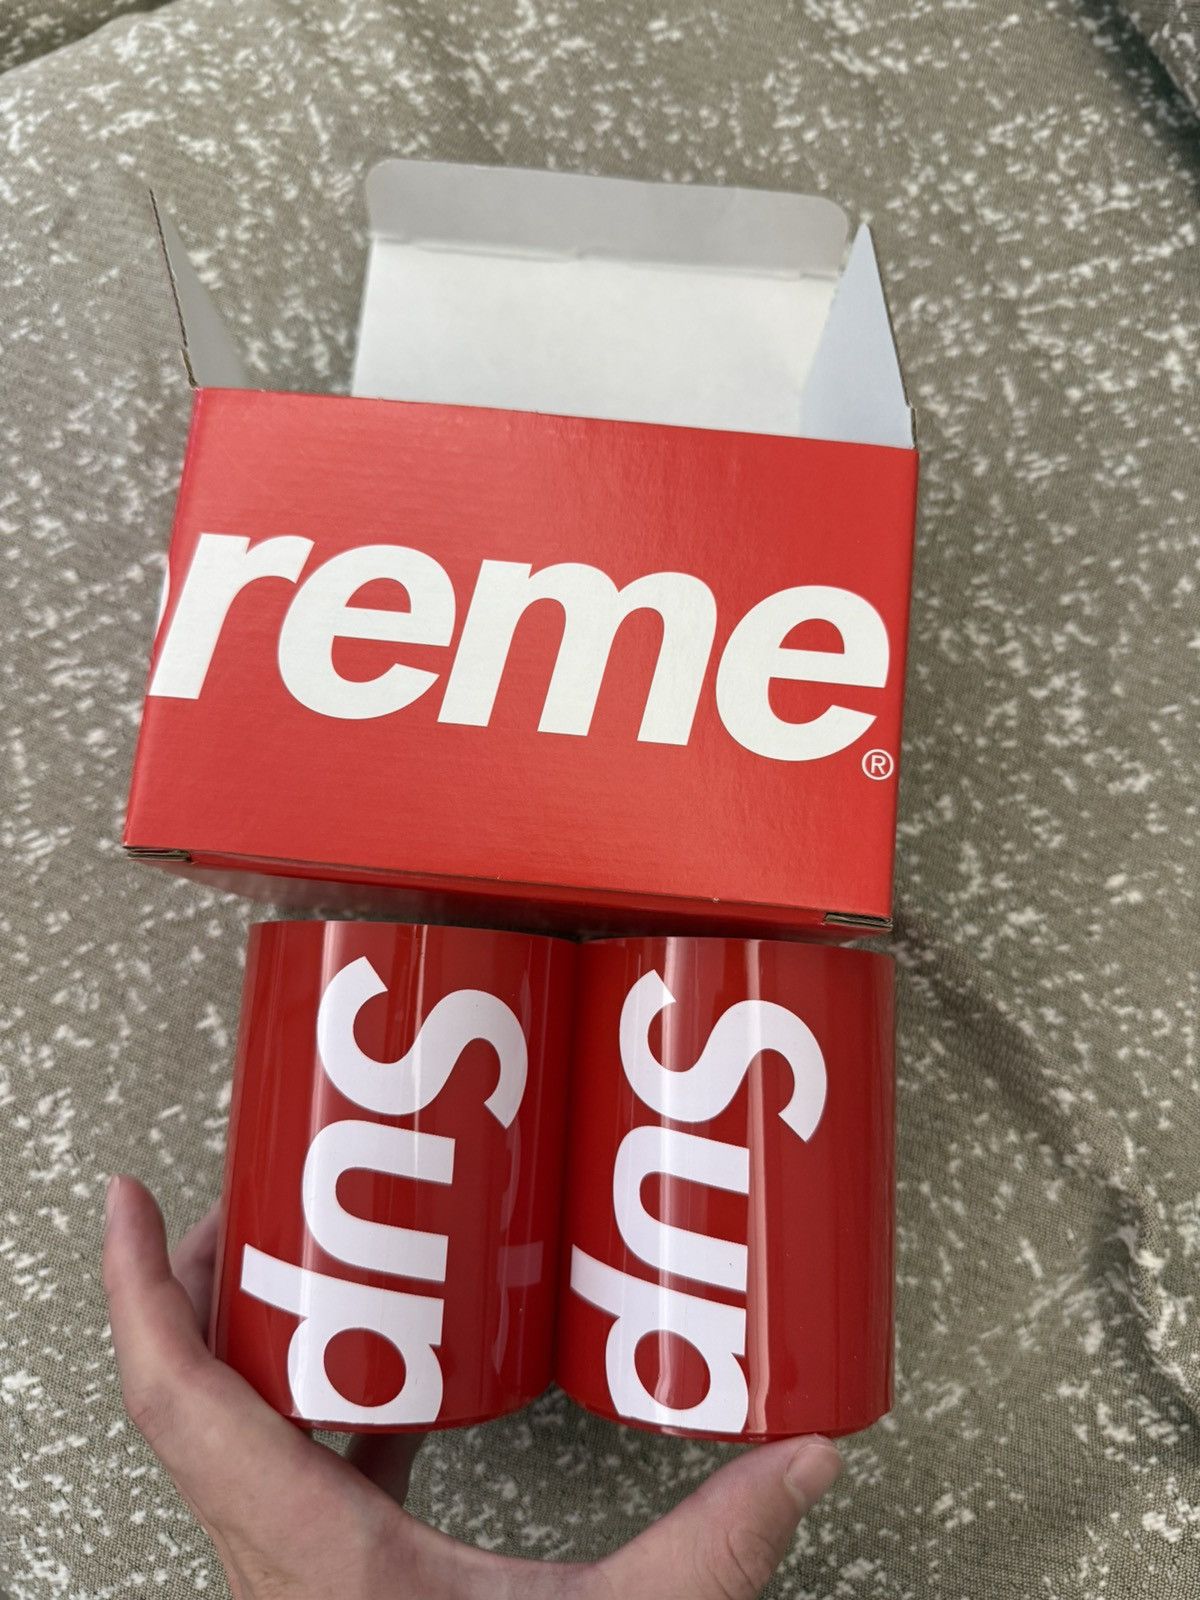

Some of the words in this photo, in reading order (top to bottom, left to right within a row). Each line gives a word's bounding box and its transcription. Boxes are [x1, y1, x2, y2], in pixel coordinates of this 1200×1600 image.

[147, 532, 890, 762] reme
[240, 955, 528, 1425] Sup
[571, 969, 827, 1434] Sup
